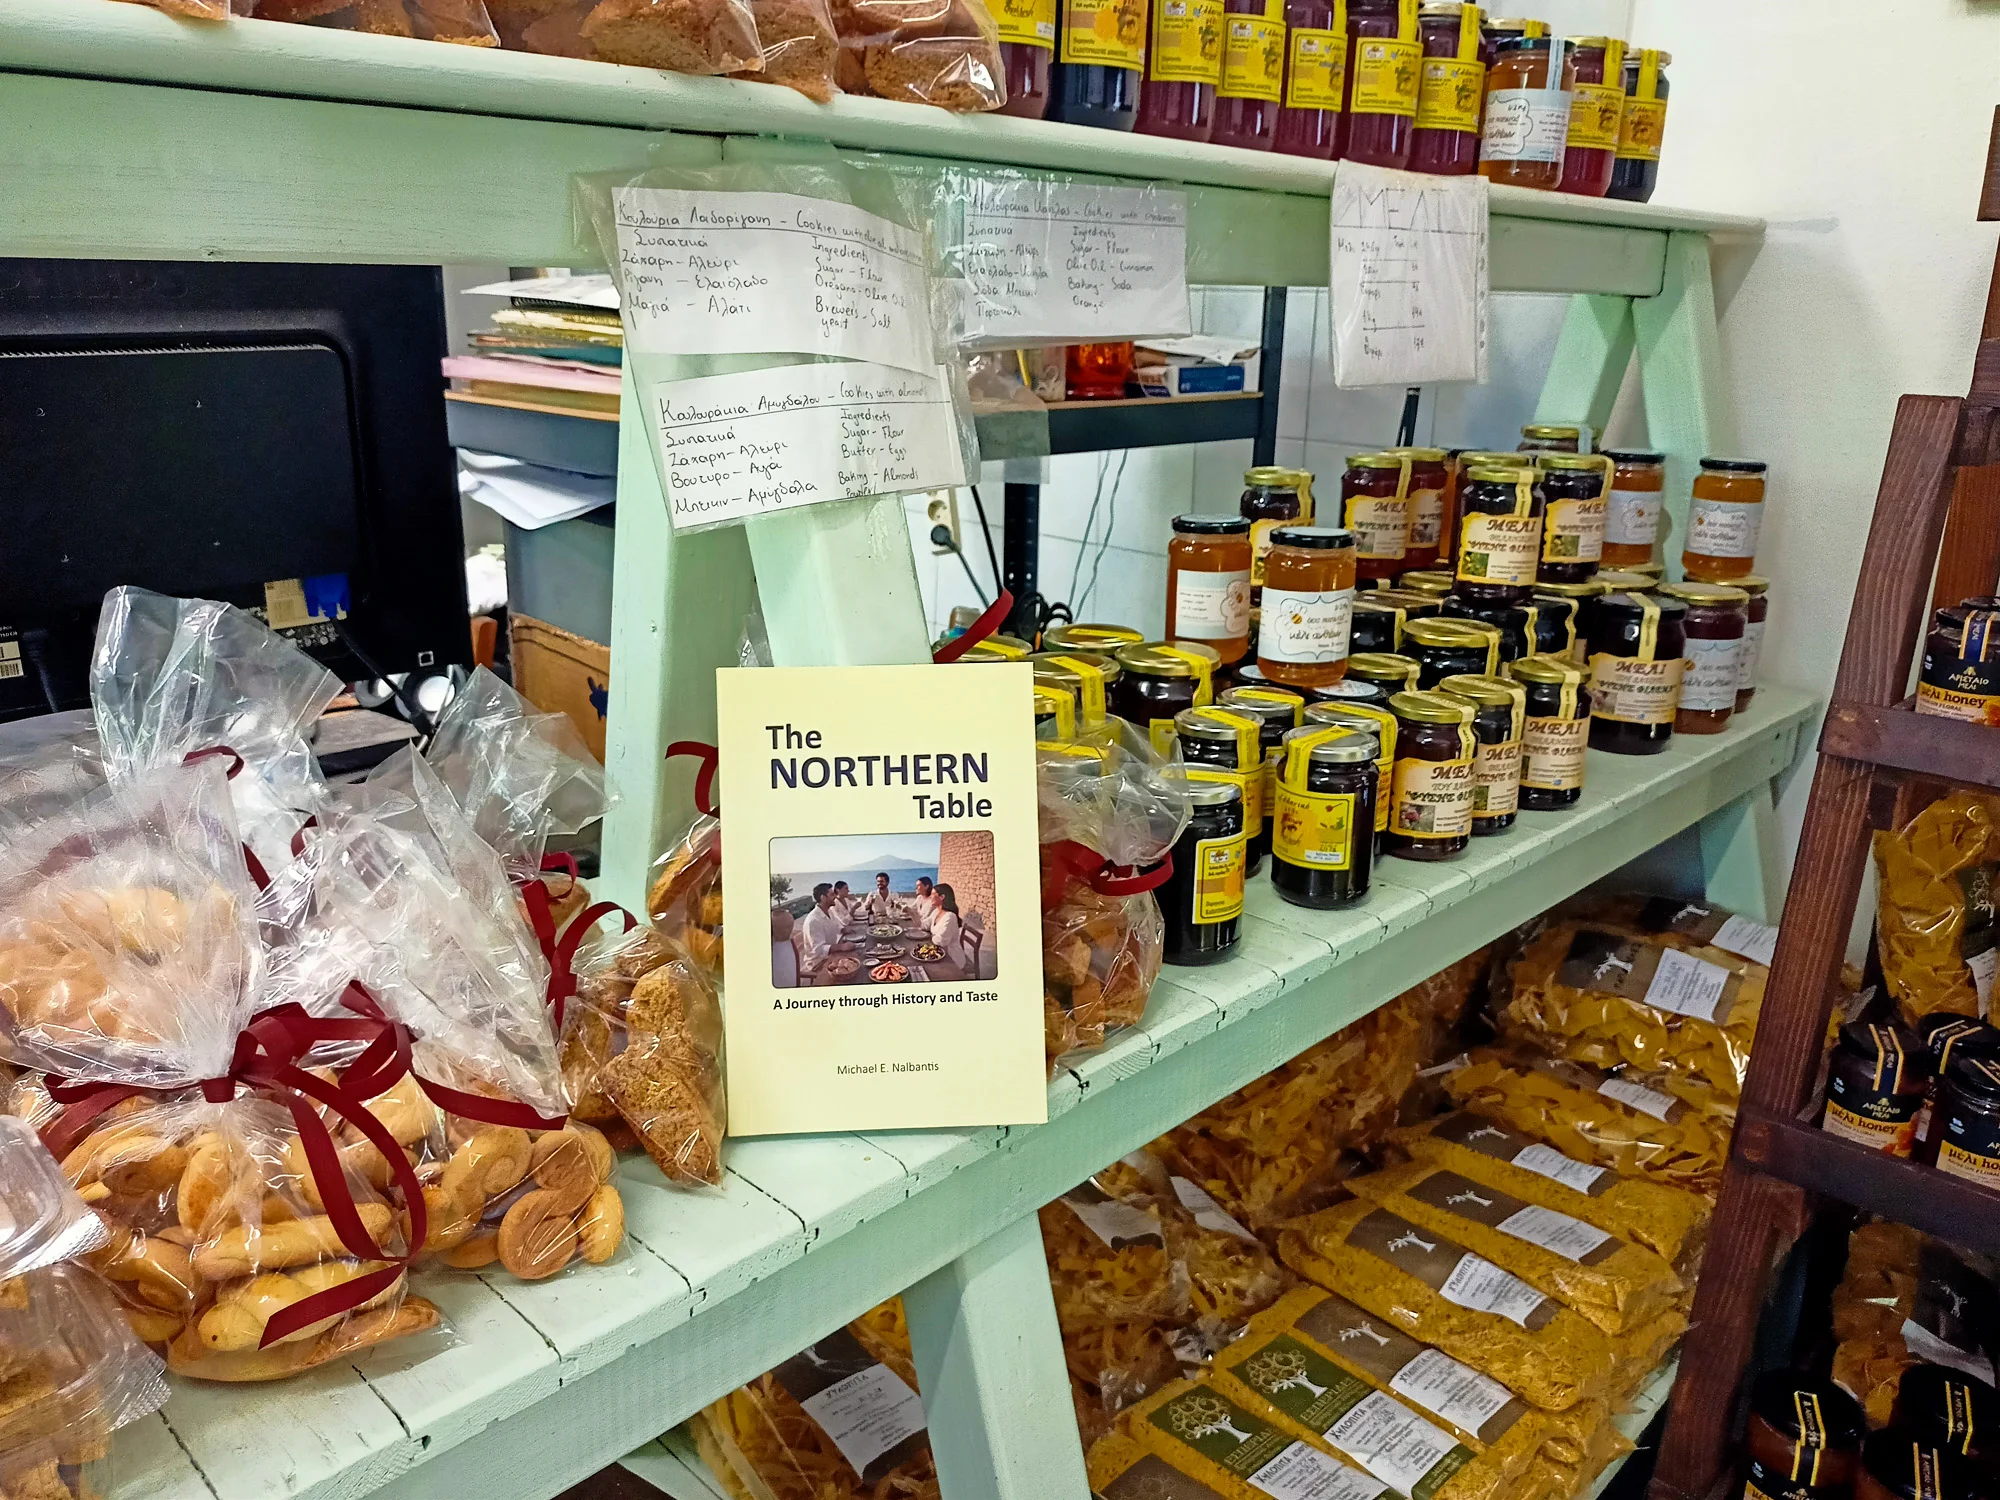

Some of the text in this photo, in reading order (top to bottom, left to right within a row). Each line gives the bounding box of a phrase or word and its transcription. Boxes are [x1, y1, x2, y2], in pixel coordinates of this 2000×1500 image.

[796, 210, 837, 236] Cookies
[1072, 226, 1116, 242] Ingredients
[812, 236, 869, 264] Ingredients
[1070, 240, 1130, 257] Sugar Flour
[815, 257, 844, 280] Sugar
[1067, 276, 1133, 296] Baking Soda
[840, 381, 874, 400] Cookies
[877, 387, 895, 398] with
[840, 408, 891, 426] Ingredients
[841, 422, 905, 445] Sugar Flour
[841, 443, 876, 459] Butter
[838, 467, 919, 486] Baking Almonds
[1486, 519, 1537, 533] ΜΕΛΙ
[1615, 661, 1667, 676] ΜΕΛΙ
[1943, 690, 1987, 709] honey
[766, 724, 822, 749] The
[1527, 721, 1583, 736] ΜΕΛΙ
[771, 753, 988, 789] NORTHERN
[1431, 763, 1475, 780] ΜΕΛ
[913, 792, 992, 819] Table
[773, 990, 999, 1011] A Journey through History and Taste
[837, 1061, 940, 1075] Michael E. Nalbantis
[1858, 1116, 1899, 1135] honey
